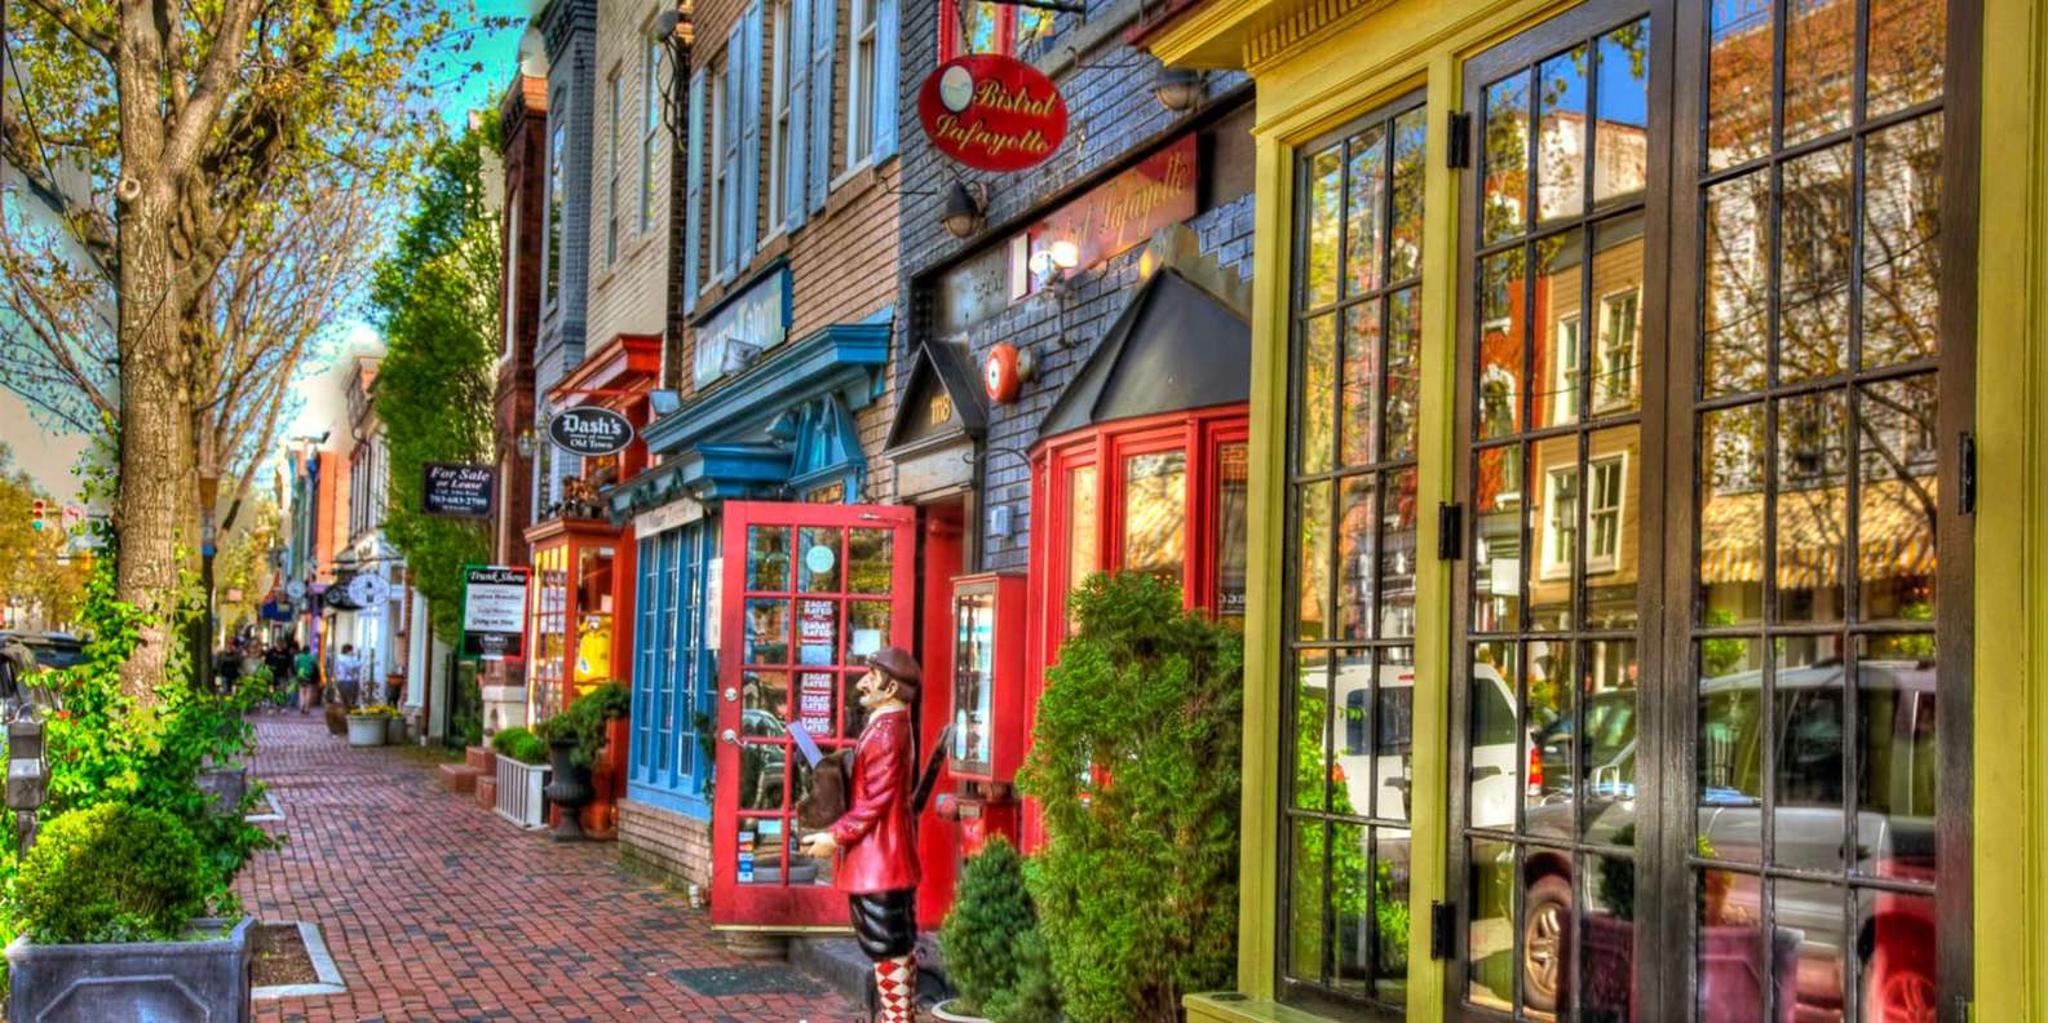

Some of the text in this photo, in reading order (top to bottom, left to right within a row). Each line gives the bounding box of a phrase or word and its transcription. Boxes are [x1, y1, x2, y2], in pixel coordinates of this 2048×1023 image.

[973, 79, 1057, 117] Bistrot
[936, 115, 1049, 155] Lafayette
[930, 394, 951, 425] 1118
[563, 414, 621, 435] Dash's
[570, 439, 613, 448] Old Town
[430, 467, 490, 481] For Sale
[450, 479, 482, 490] Lease
[470, 571, 525, 582] Trunk Show
